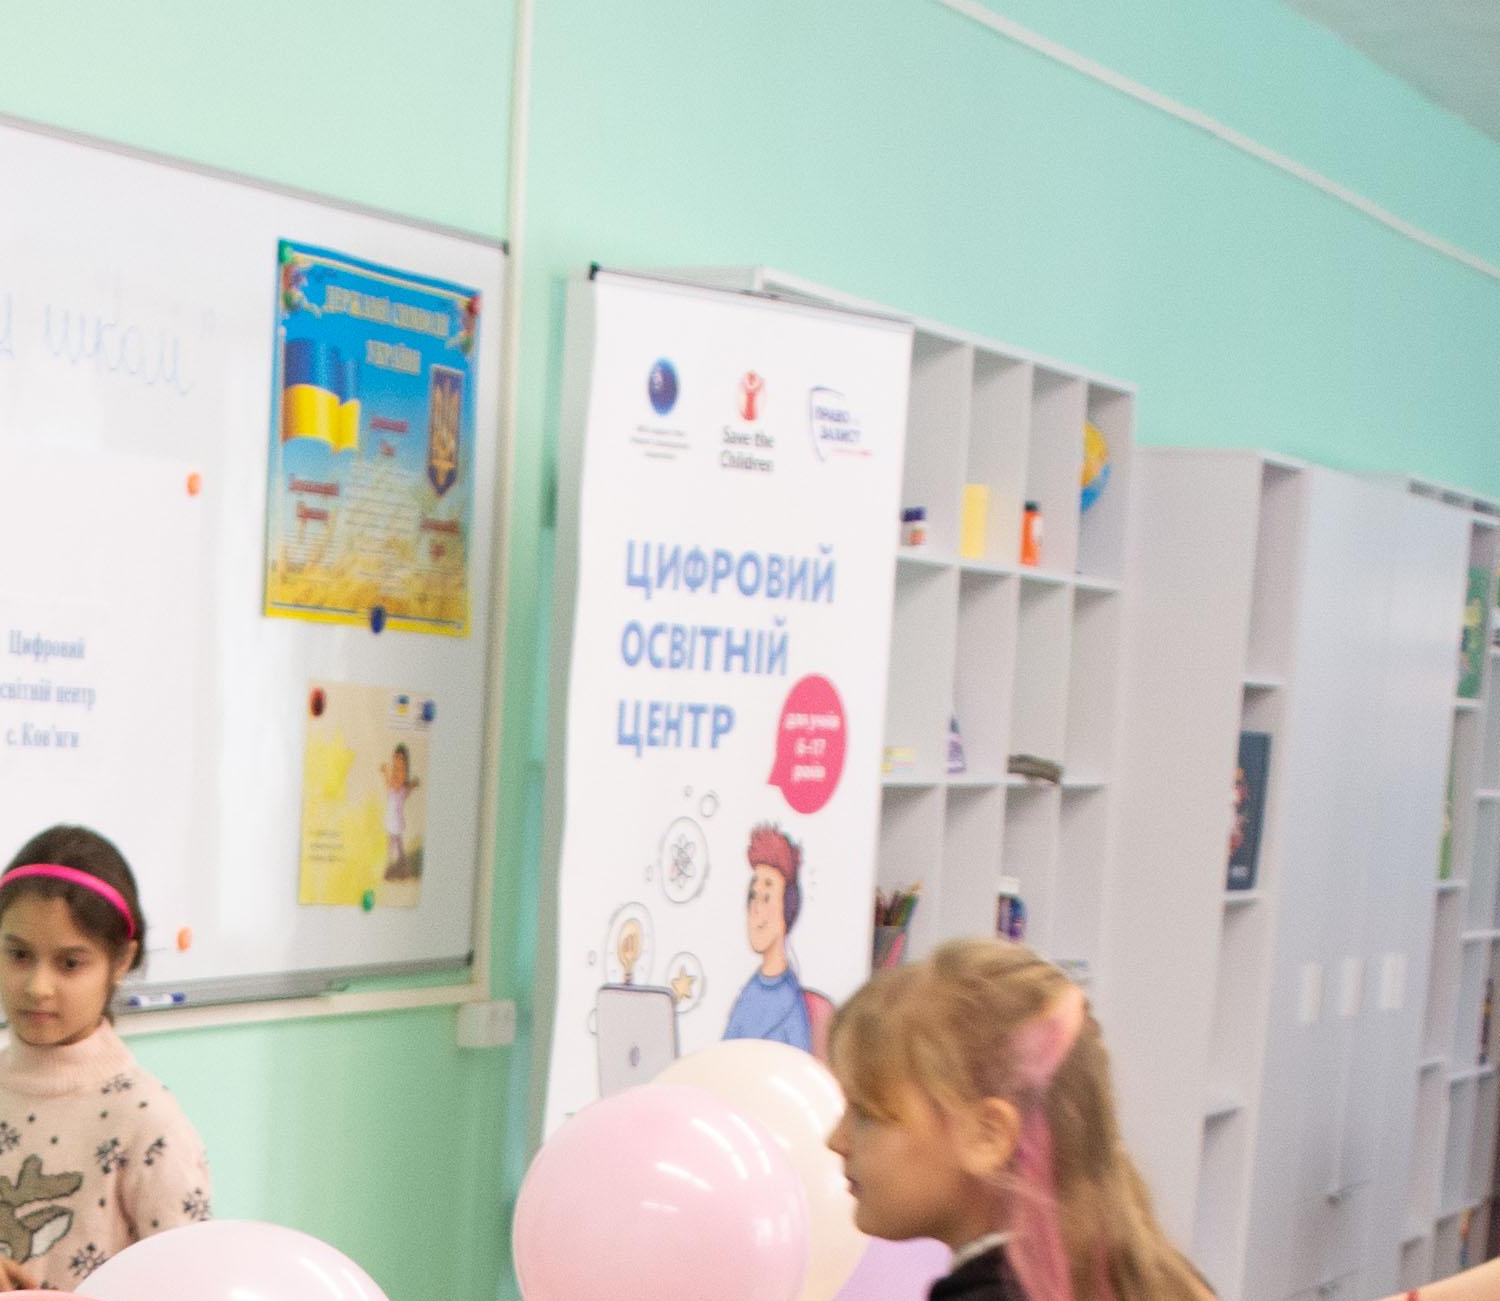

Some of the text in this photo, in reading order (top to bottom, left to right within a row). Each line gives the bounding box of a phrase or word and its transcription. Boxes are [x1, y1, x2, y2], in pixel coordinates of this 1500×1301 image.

[625, 538, 836, 603] ЦИФРОВИЙ
[620, 616, 789, 676] ОСВІТНІЙ
[617, 698, 736, 760] ЦЕНТР
